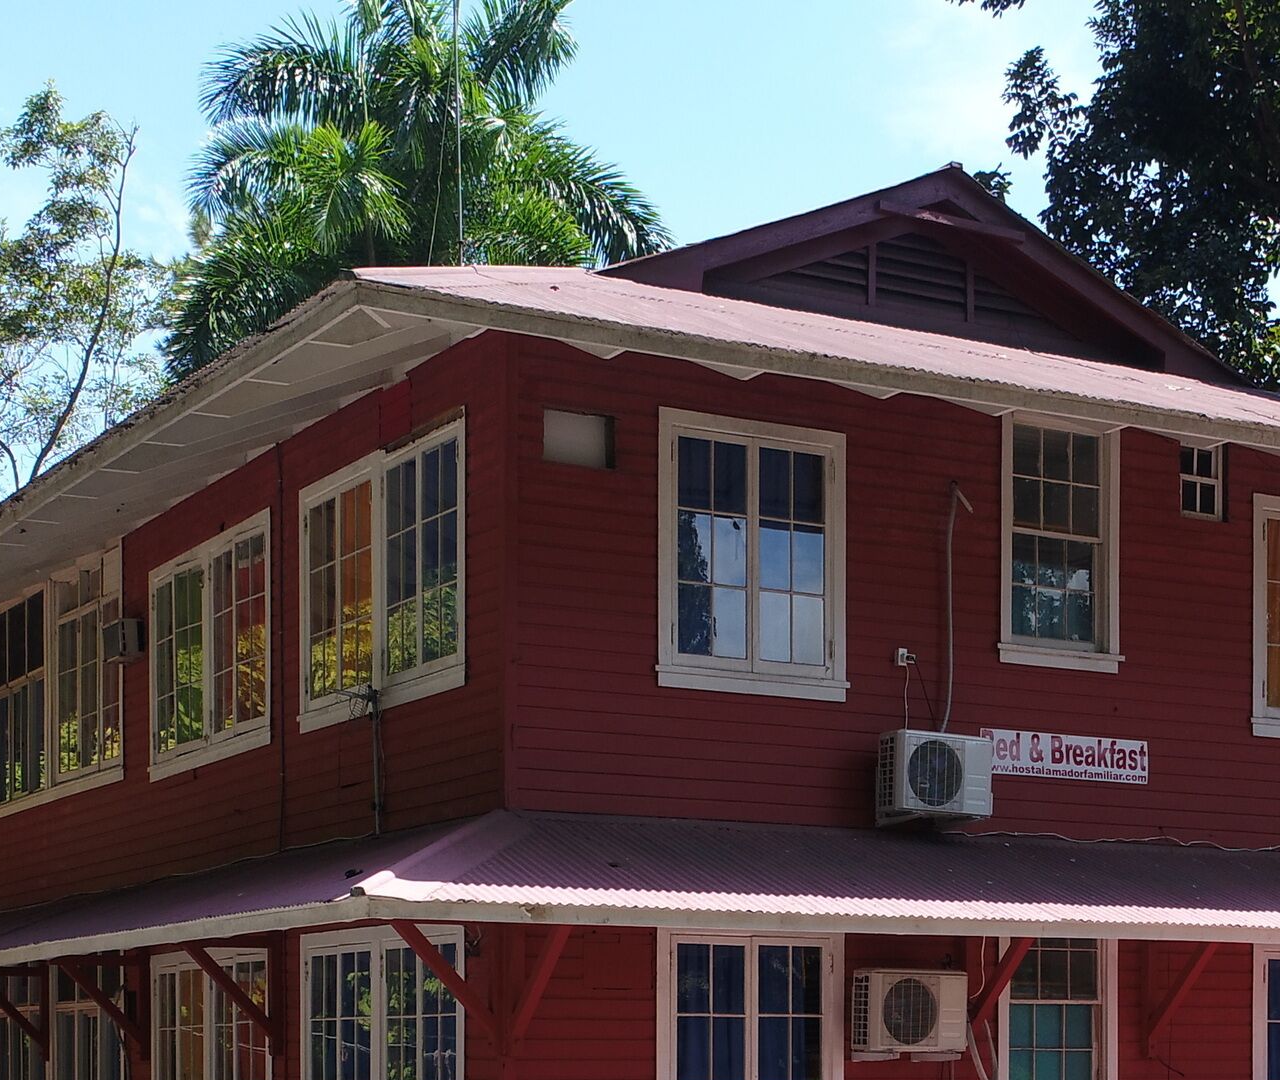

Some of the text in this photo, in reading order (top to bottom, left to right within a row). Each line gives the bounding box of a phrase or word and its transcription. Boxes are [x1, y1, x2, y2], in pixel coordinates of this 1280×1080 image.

[1029, 733, 1044, 763] &
[1050, 735, 1147, 772] Breakfast
[991, 764, 1147, 783] ww.hostalamadorfamiliar.com
